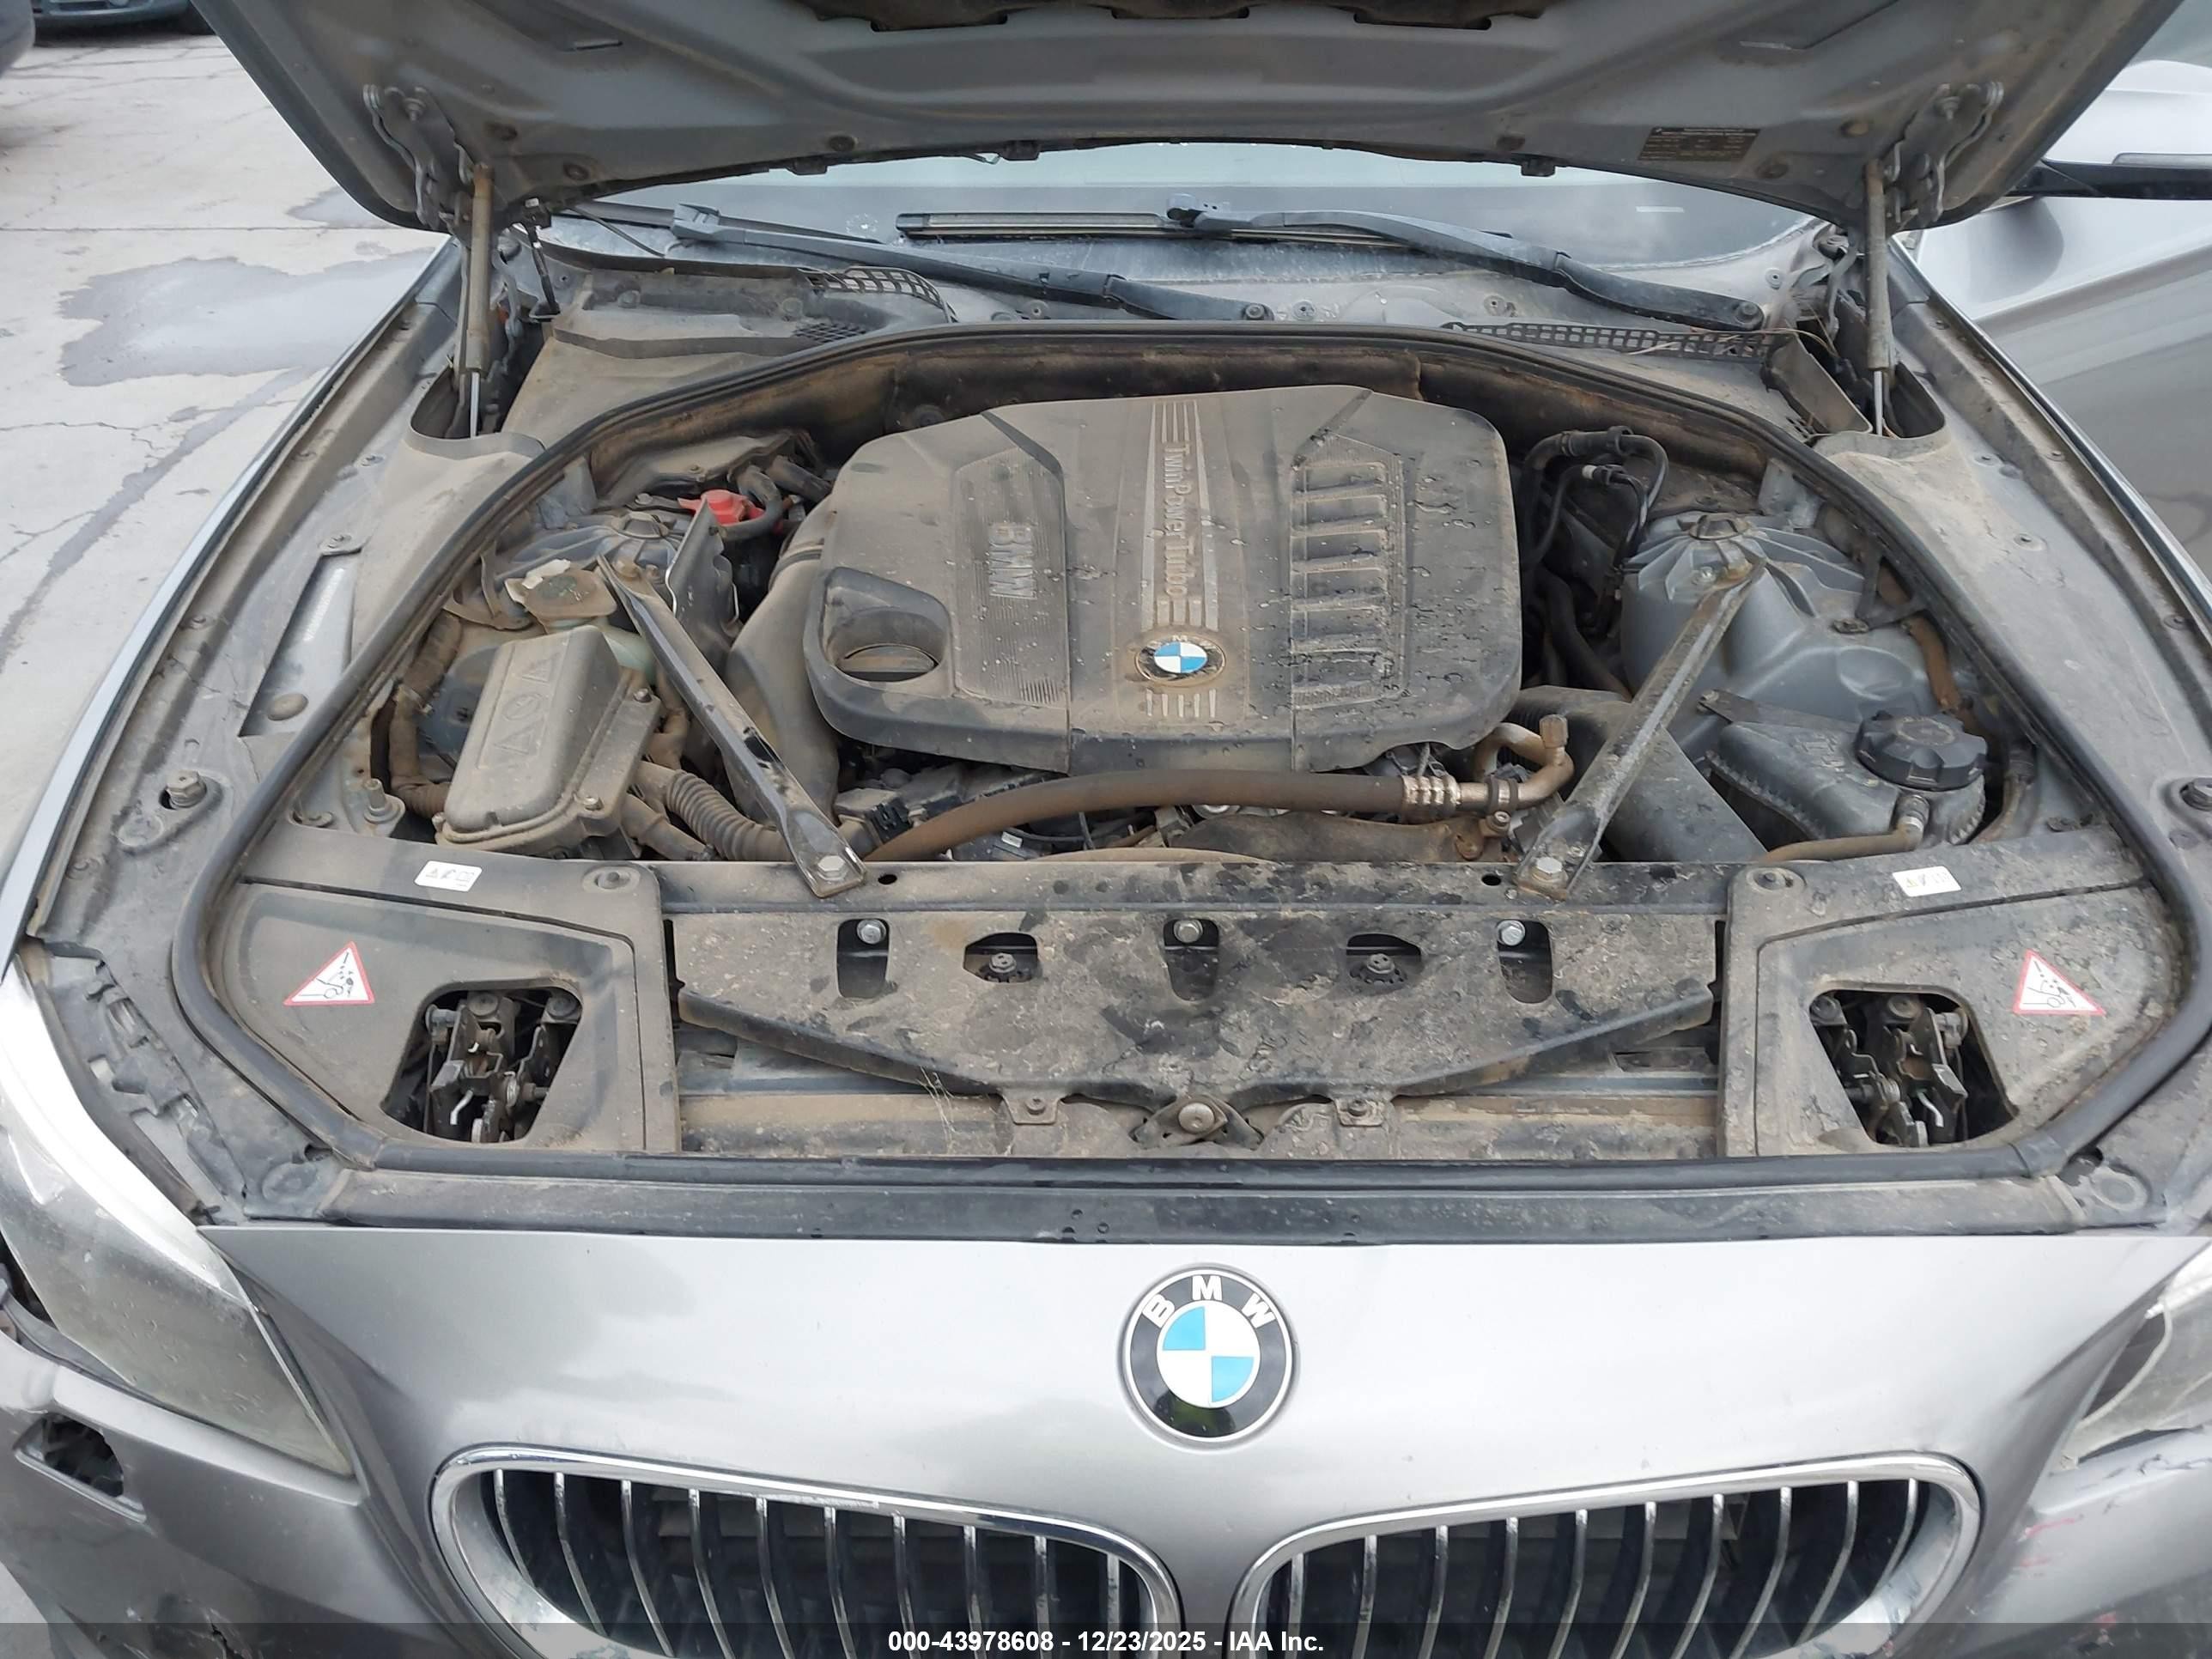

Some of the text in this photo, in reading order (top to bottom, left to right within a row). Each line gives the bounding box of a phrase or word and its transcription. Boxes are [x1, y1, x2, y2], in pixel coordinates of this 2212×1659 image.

[1164, 443, 1194, 595] TwinPower Turbo
[988, 522, 1035, 599] BMW
[1142, 1275, 1276, 1328] BMW
